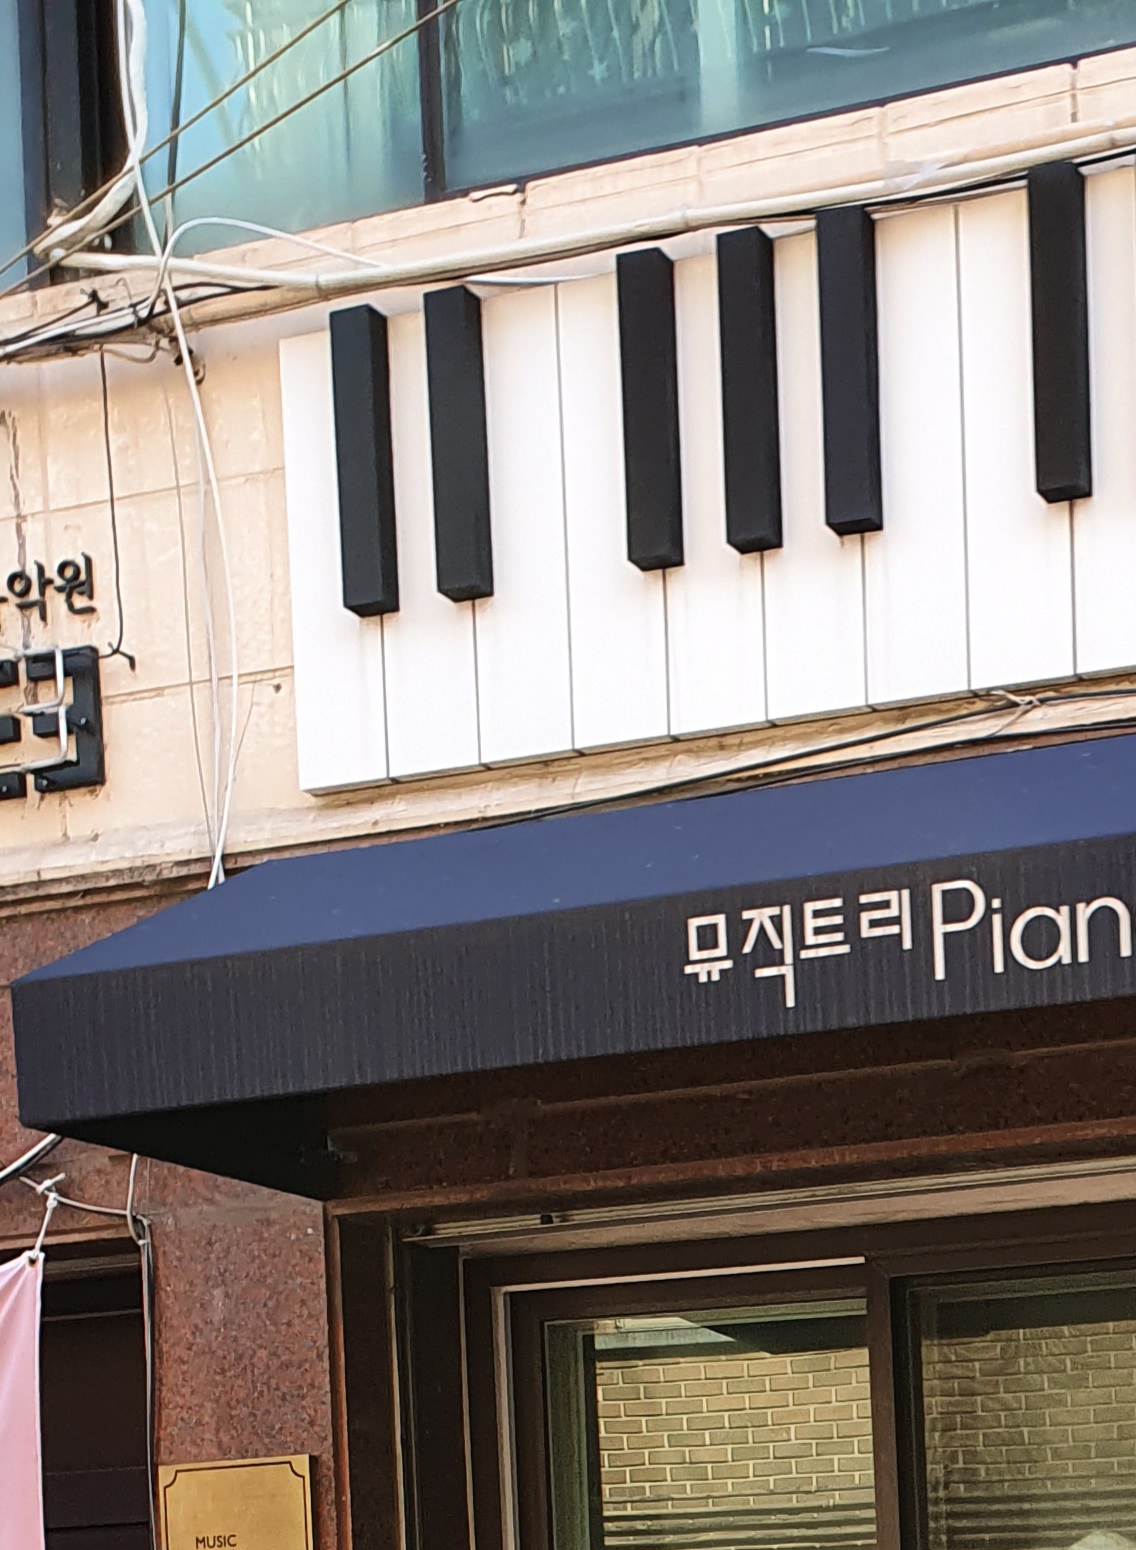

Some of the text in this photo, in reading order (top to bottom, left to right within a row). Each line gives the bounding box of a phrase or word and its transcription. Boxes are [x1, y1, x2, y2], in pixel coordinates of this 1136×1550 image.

[0, 551, 97, 622] 악원
[683, 887, 913, 1008] 뮤직트리
[195, 1534, 237, 1550] MUSIC
